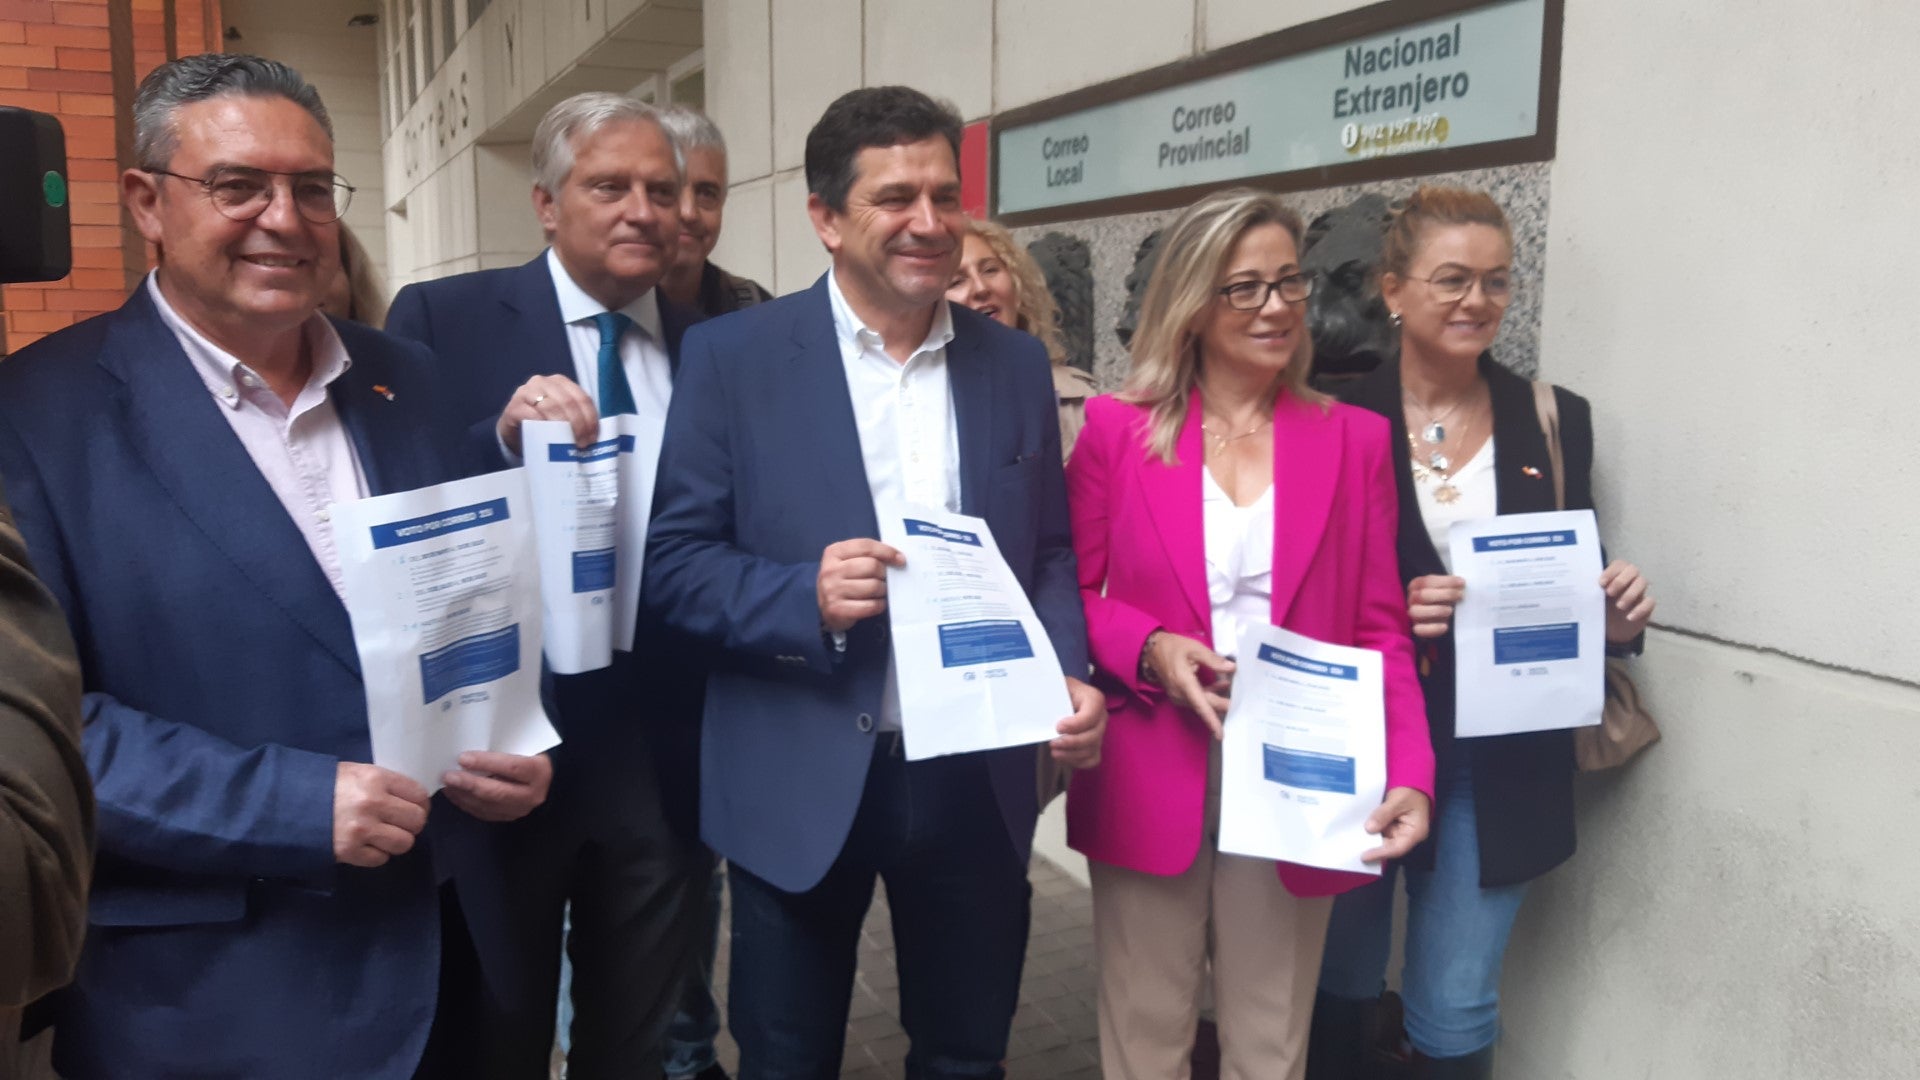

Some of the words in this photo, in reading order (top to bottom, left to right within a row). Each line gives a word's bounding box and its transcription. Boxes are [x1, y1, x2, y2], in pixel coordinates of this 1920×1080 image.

[1344, 22, 1460, 79] Nacional
[1333, 71, 1469, 118] Extranjero
[1172, 99, 1236, 134] Correo
[1042, 133, 1089, 160] Correo
[1158, 126, 1250, 168] Provincial
[1046, 160, 1084, 187] Local
